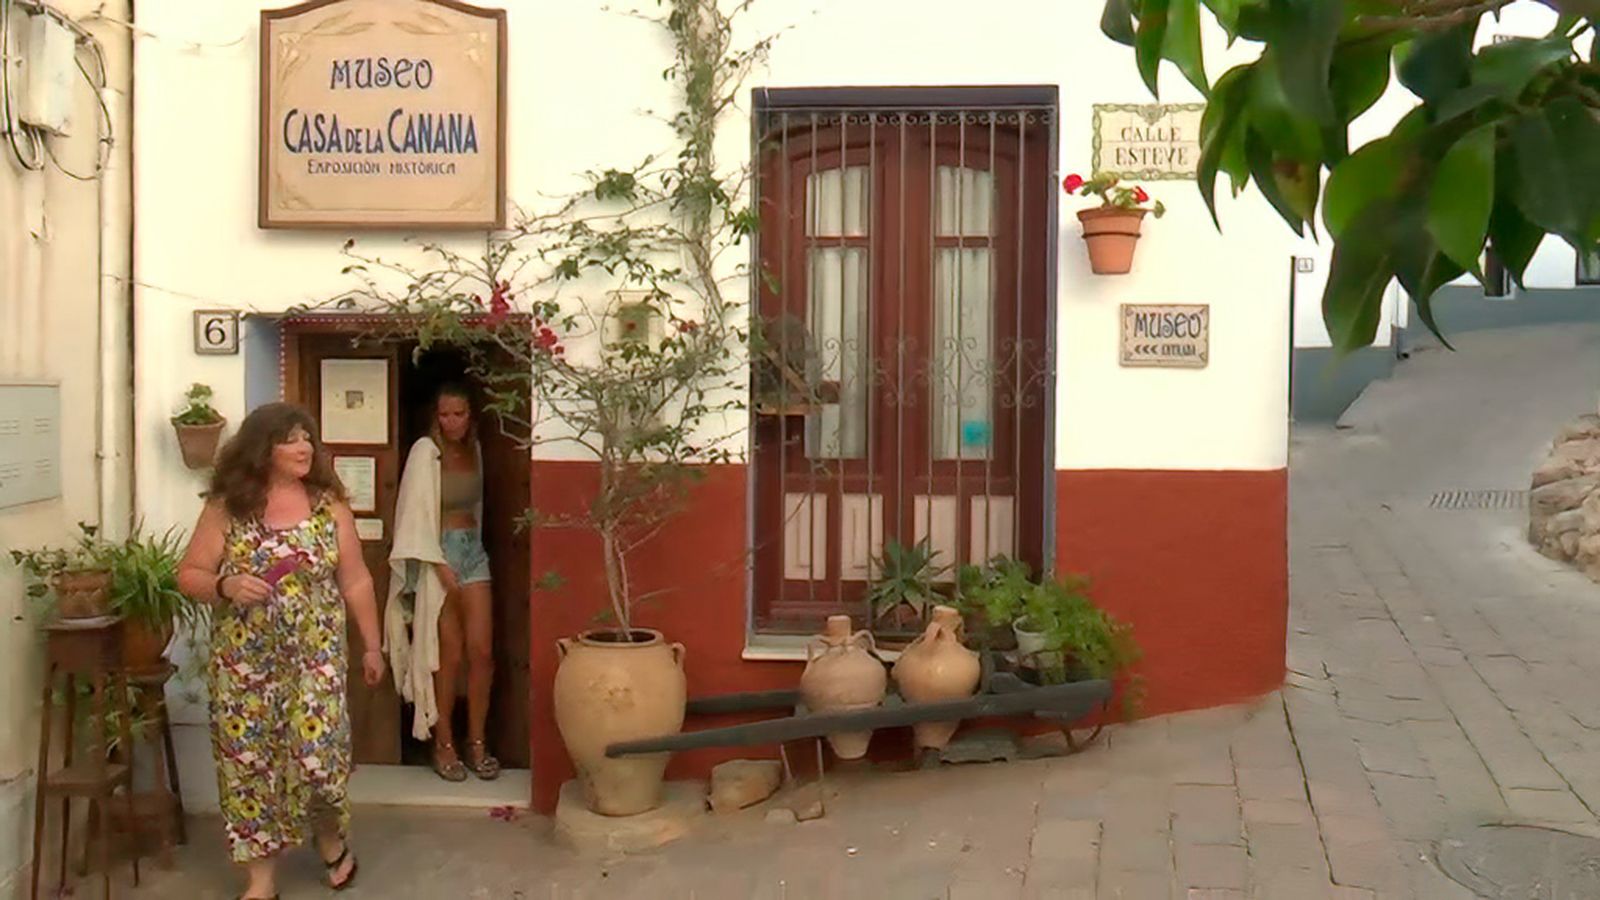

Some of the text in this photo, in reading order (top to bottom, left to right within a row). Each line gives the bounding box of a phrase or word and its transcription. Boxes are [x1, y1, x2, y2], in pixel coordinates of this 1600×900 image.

[330, 57, 433, 90] MUSEO
[283, 108, 479, 154] CASA DE LA CANANA
[1121, 127, 1182, 142] CALLE
[1116, 147, 1188, 166] ESTEVE
[205, 317, 226, 345] 6
[1133, 312, 1202, 339] MUSEO
